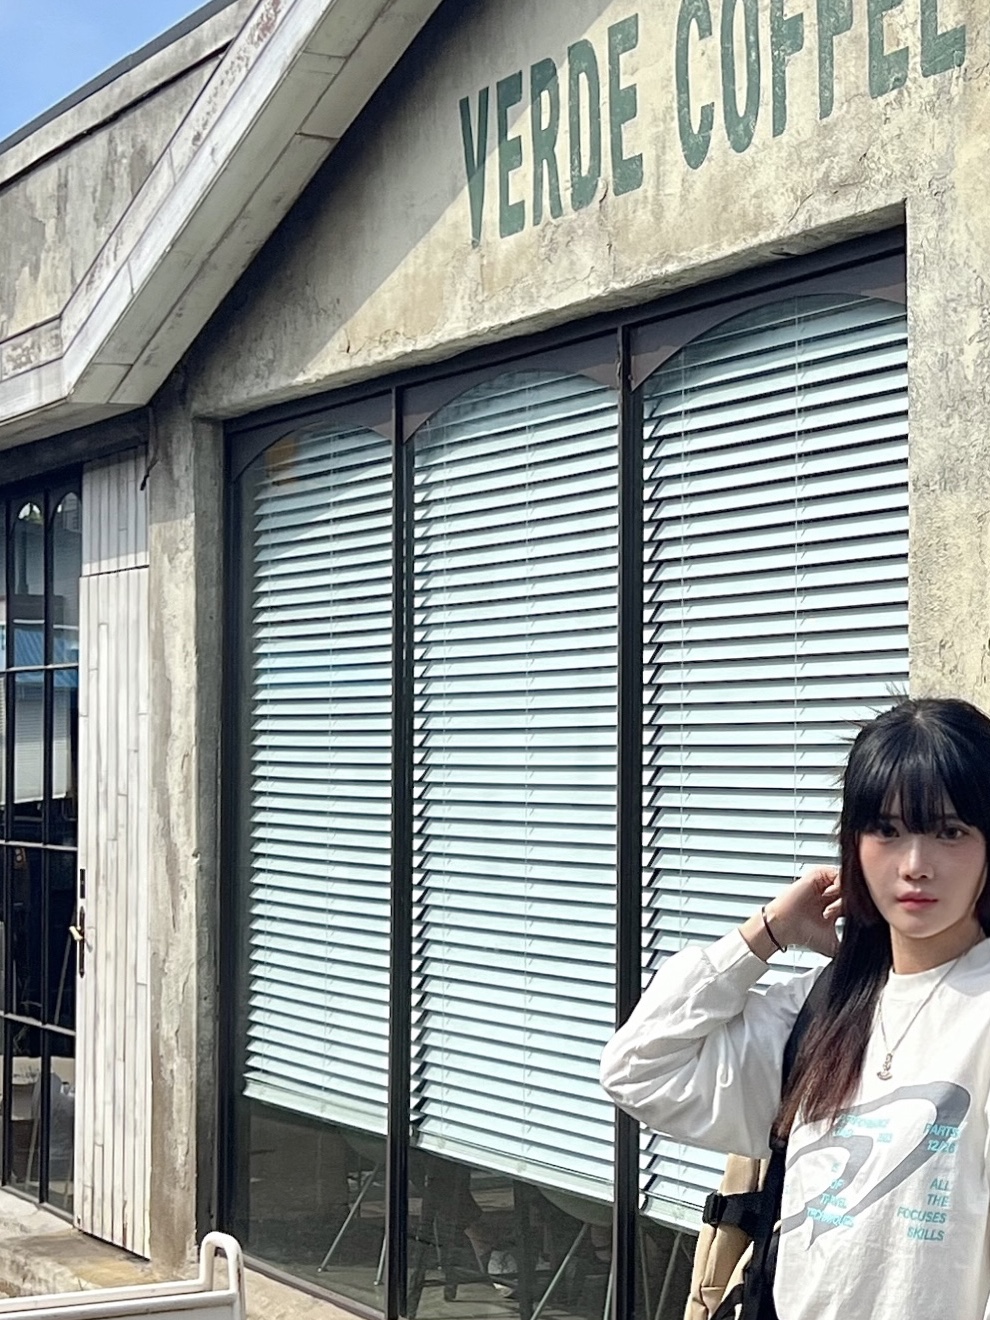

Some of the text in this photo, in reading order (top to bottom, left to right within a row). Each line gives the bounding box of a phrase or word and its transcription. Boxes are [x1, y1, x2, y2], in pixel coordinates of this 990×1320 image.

[459, 13, 643, 249] VERDE
[930, 1178, 951, 1192] ALL
[927, 1194, 949, 1207] THE
[897, 1207, 947, 1223] FOCUSES
[907, 1227, 944, 1241] SKILLS
